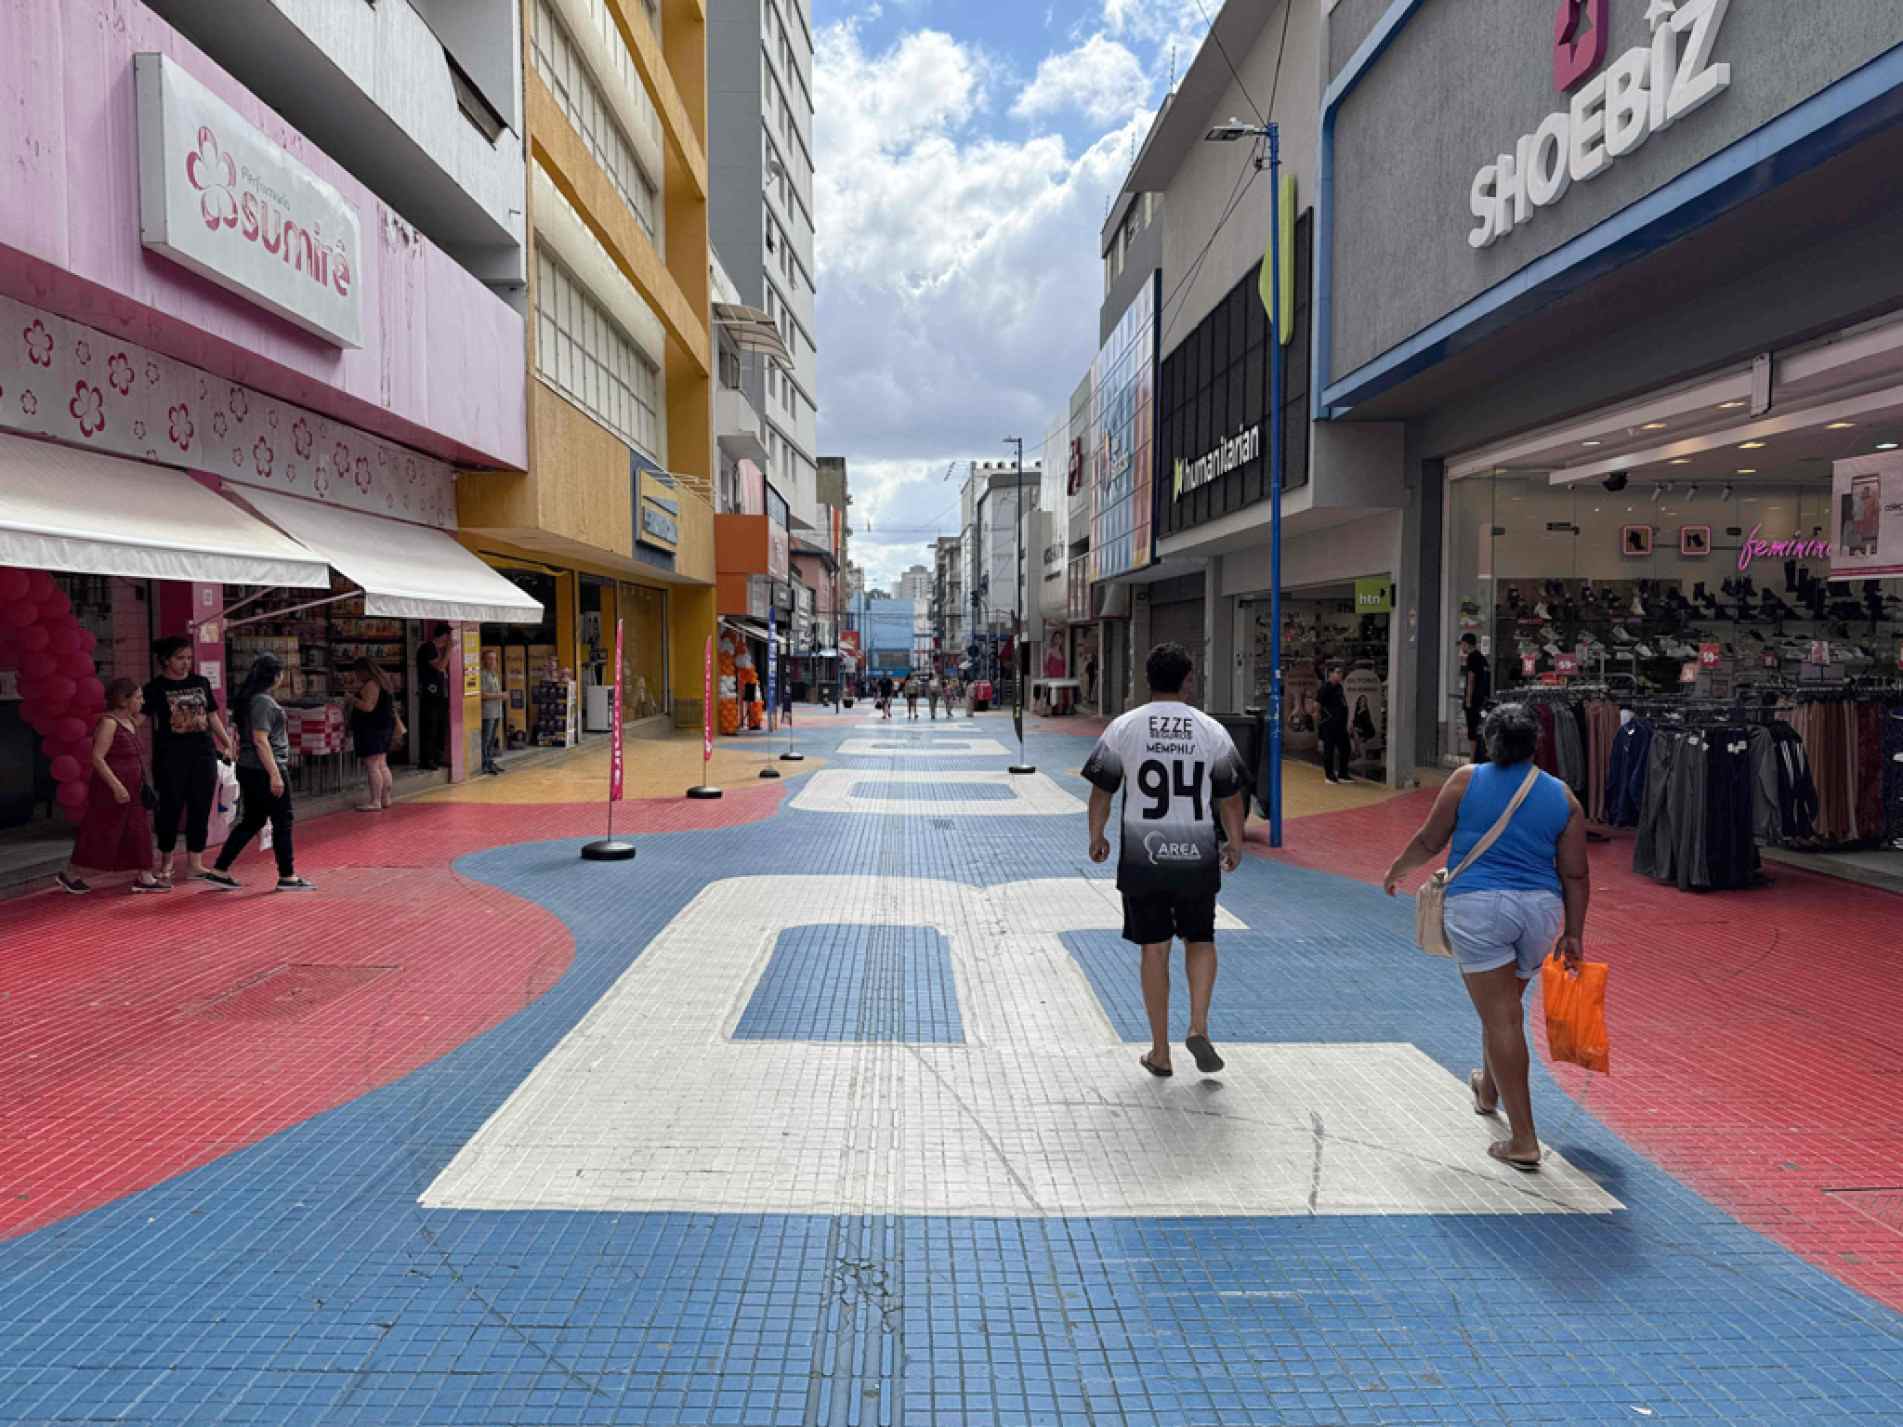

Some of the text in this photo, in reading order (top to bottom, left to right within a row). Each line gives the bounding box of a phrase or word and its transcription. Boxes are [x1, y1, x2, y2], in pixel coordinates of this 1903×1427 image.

[1468, 0, 1730, 247] SHOEBIZ
[242, 191, 350, 296] sumirê
[1183, 423, 1259, 494] humanitarian
[1146, 743, 1196, 755] MEMPHIS
[1149, 716, 1193, 732] EZZE
[1138, 759, 1204, 821] 94
[1158, 843, 1200, 856] AREA
